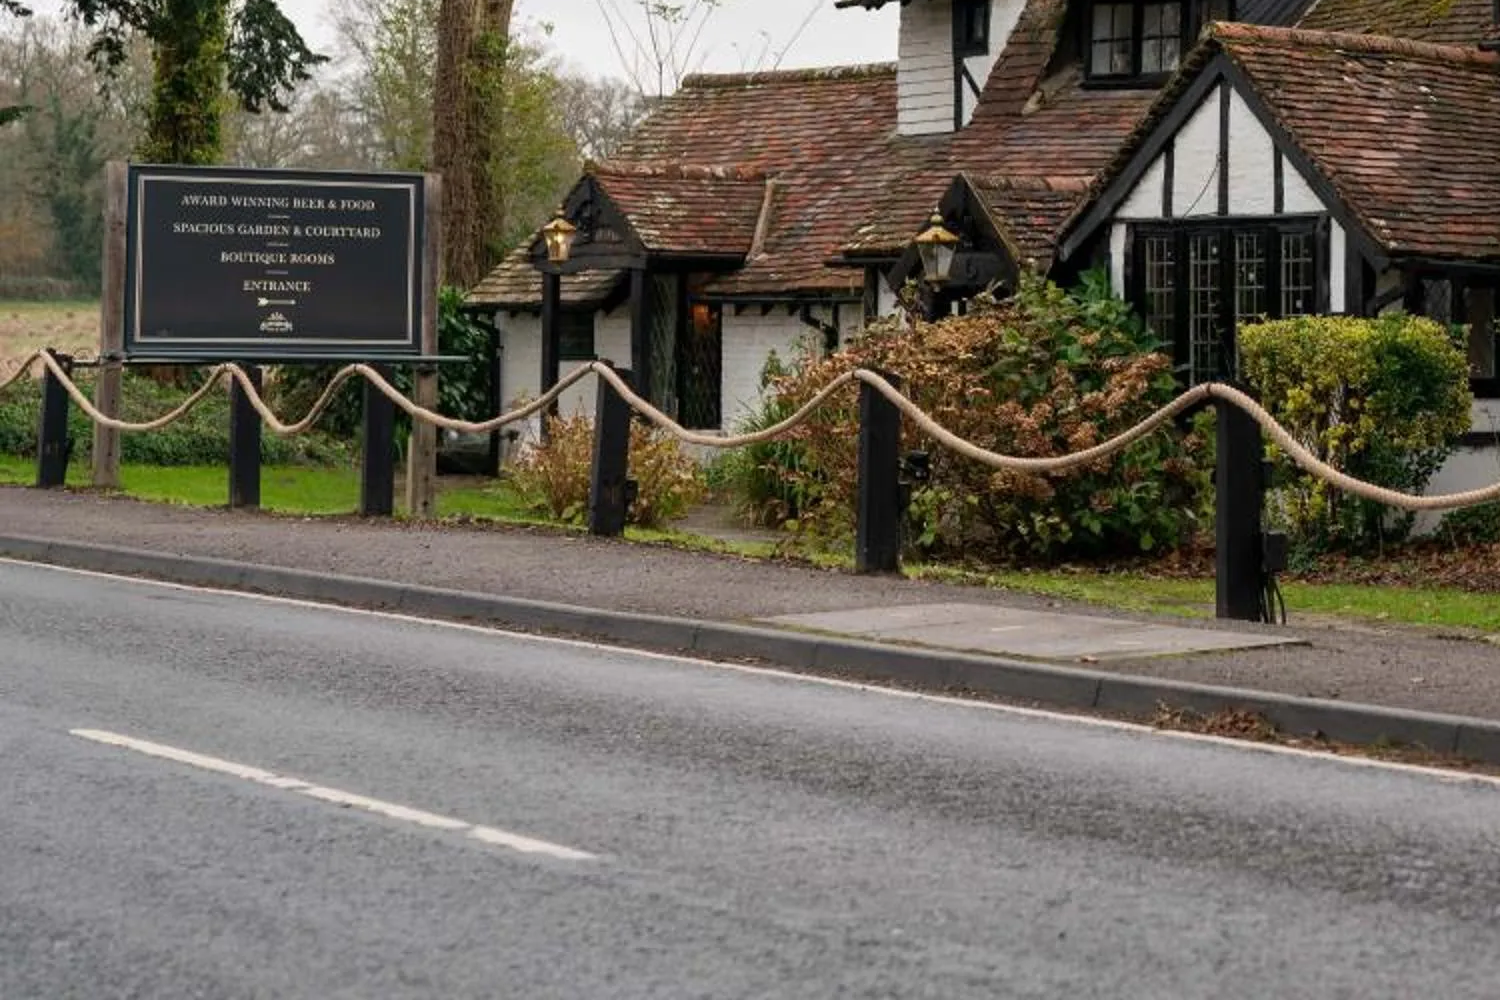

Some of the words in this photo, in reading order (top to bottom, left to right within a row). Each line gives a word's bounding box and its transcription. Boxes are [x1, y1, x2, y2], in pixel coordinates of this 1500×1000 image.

[181, 195, 228, 206] AWARD
[231, 196, 289, 208] WINNING
[293, 197, 325, 209] BEER
[327, 199, 337, 209] &
[340, 199, 376, 211] FOOD
[173, 223, 235, 235] SPACIOUS
[238, 224, 290, 236] GARDEN
[293, 225, 302, 236] &
[304, 225, 381, 238] COURTYARD
[220, 252, 287, 265] BOUTIQUE
[290, 253, 335, 265] ROOMS
[243, 280, 311, 292] ENTRANCE
